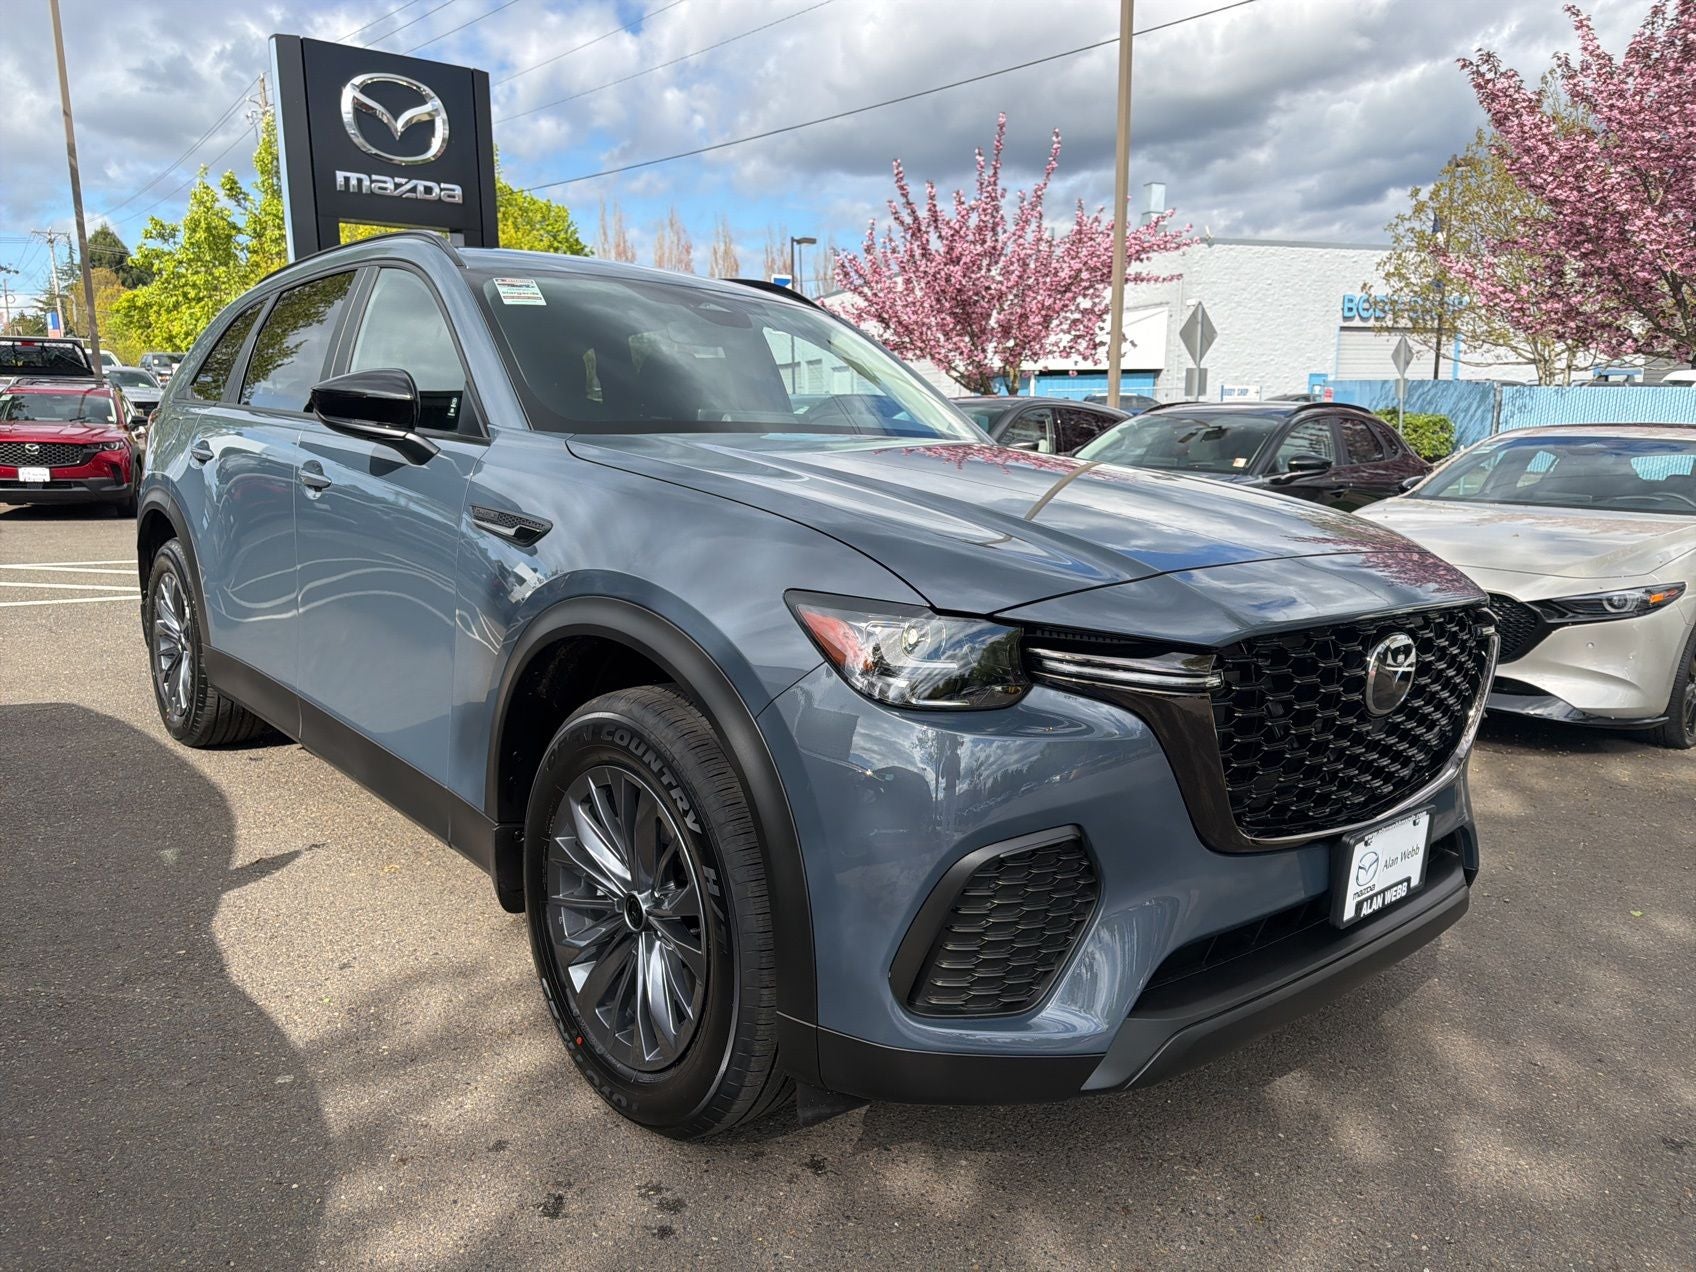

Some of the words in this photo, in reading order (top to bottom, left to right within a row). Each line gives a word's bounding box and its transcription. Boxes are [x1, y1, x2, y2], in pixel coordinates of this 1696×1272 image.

[600, 724, 703, 834] COUNTRY
[1382, 855, 1399, 873] Alan
[1400, 844, 1420, 864] Webb
[1360, 893, 1384, 918] ALAN
[1384, 881, 1408, 906] WEBB
